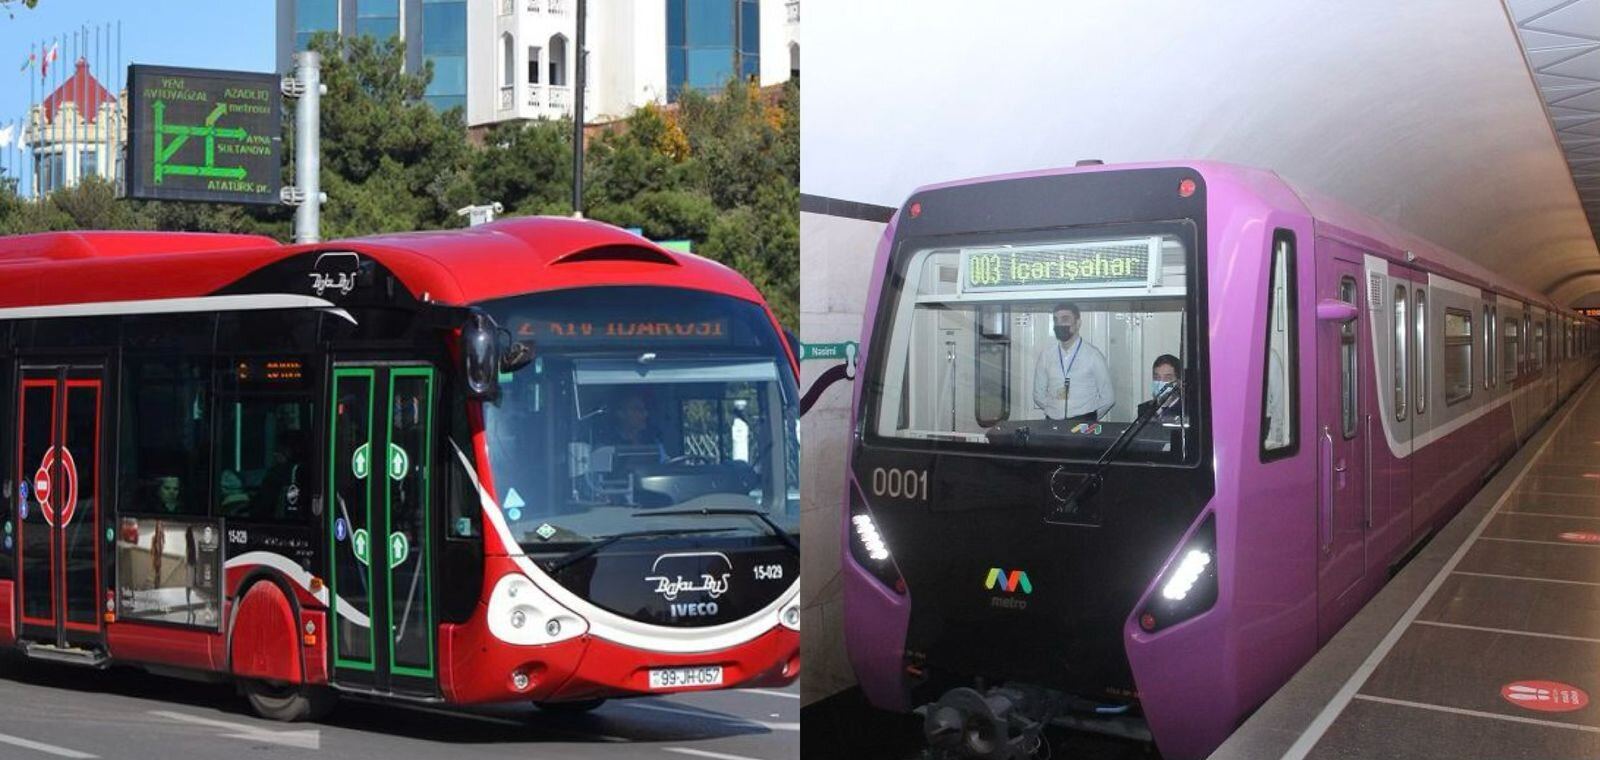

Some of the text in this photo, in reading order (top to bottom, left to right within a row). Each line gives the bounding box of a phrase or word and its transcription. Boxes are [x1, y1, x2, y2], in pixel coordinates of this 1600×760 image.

[873, 468, 928, 500] 0001
[753, 564, 783, 580] 15-029
[670, 602, 718, 617] IVECO
[992, 596, 1026, 610] metro
[661, 667, 720, 686] 99-JH-057
